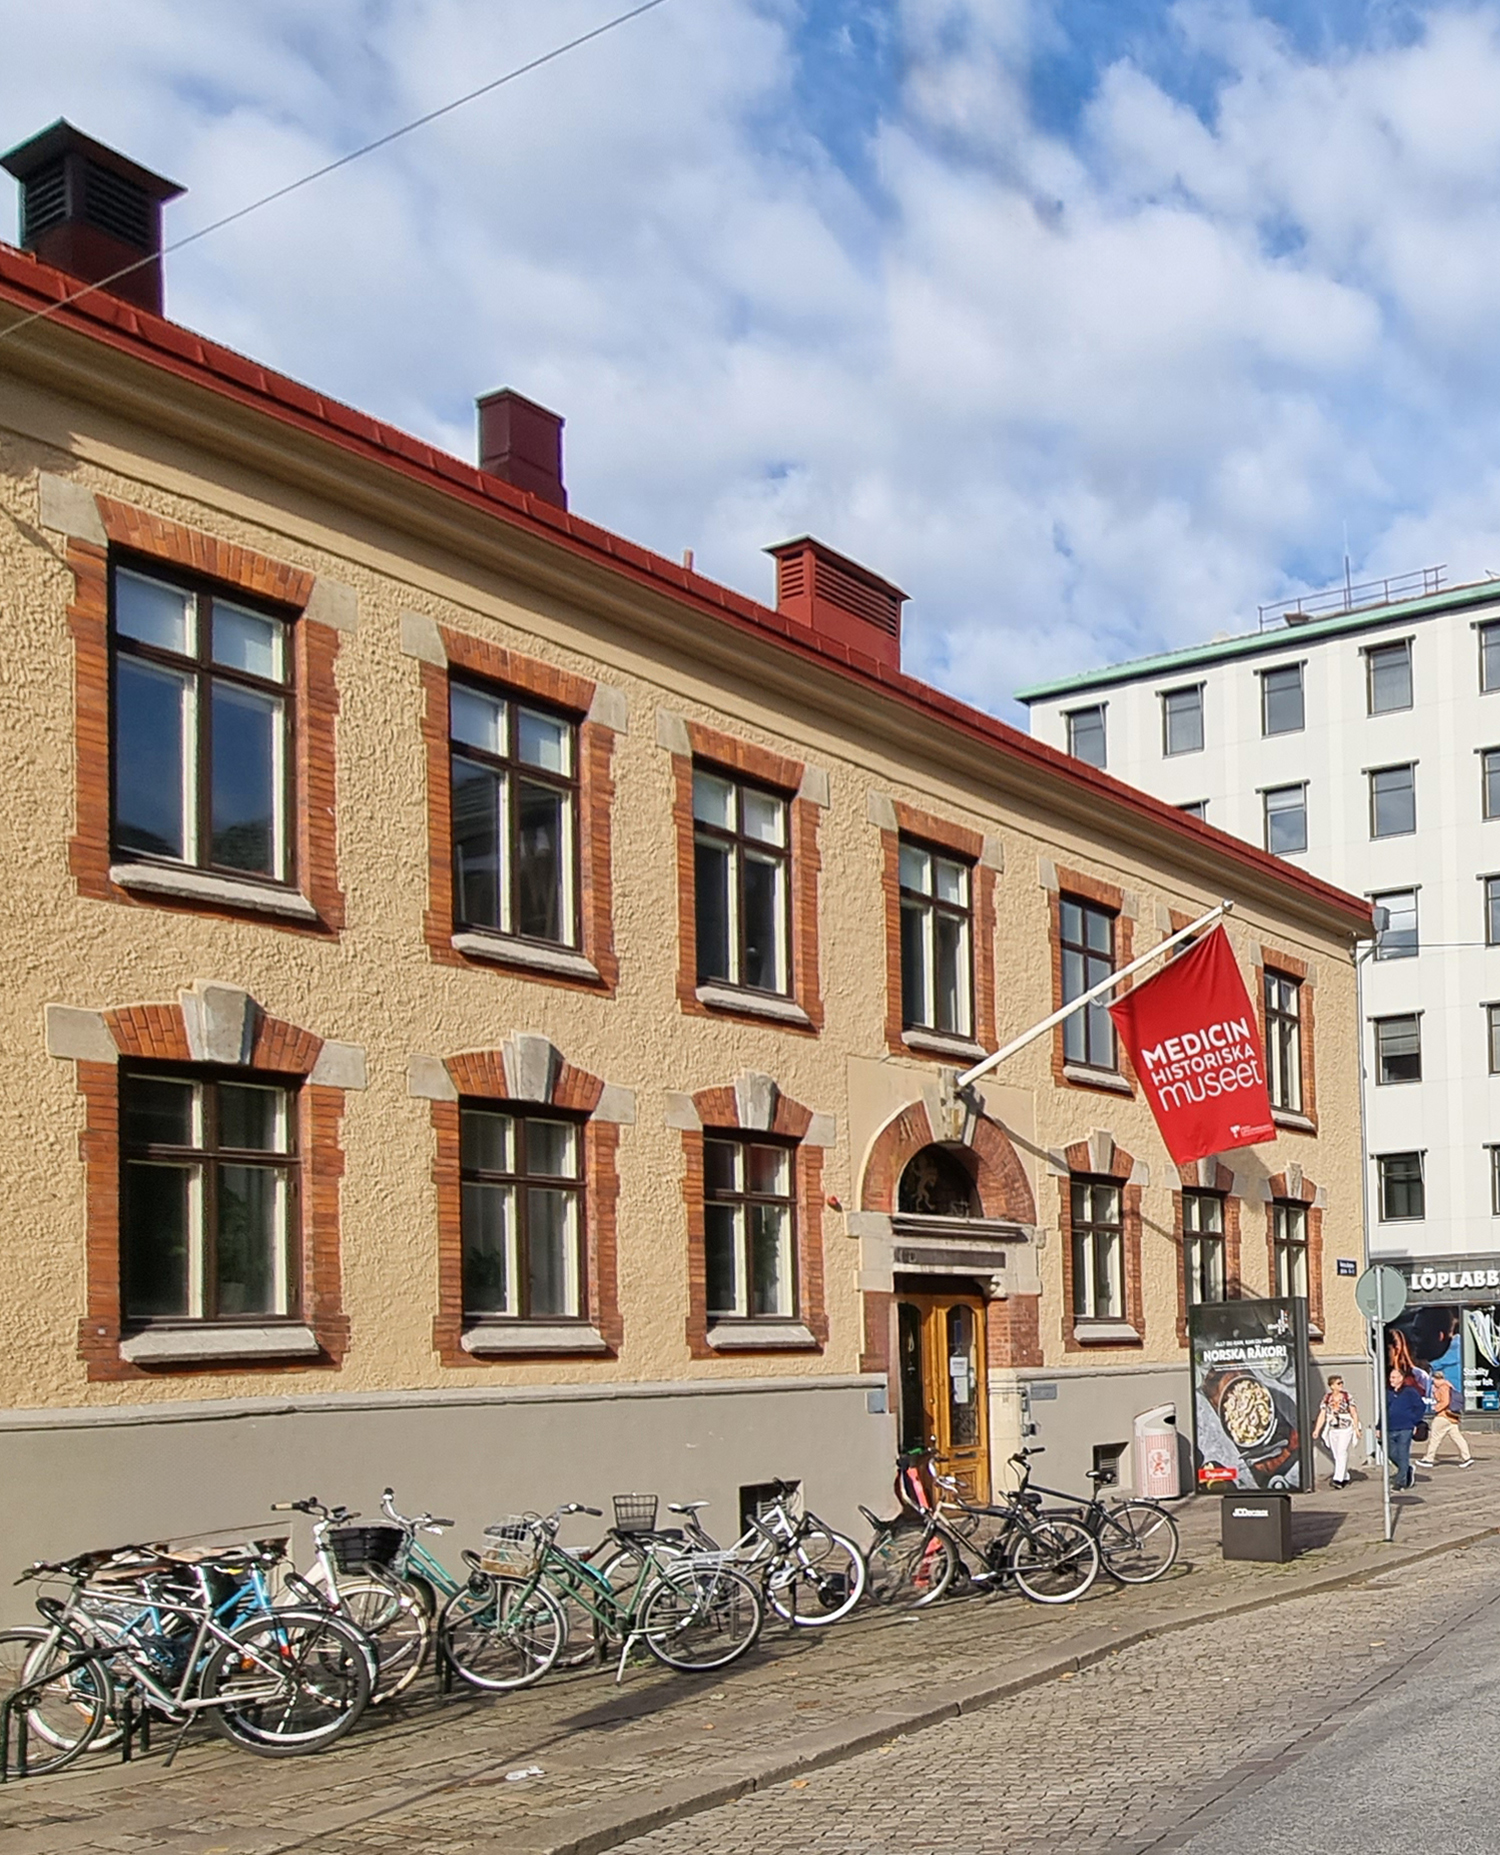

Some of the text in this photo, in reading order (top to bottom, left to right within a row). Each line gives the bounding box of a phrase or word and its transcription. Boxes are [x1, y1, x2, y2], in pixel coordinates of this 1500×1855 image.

[1141, 1017, 1251, 1070] MEDICIN
[1150, 1042, 1256, 1086] HISTORISKA
[1157, 1059, 1263, 1112] museet
[1203, 1348, 1246, 1362] NORSKA
